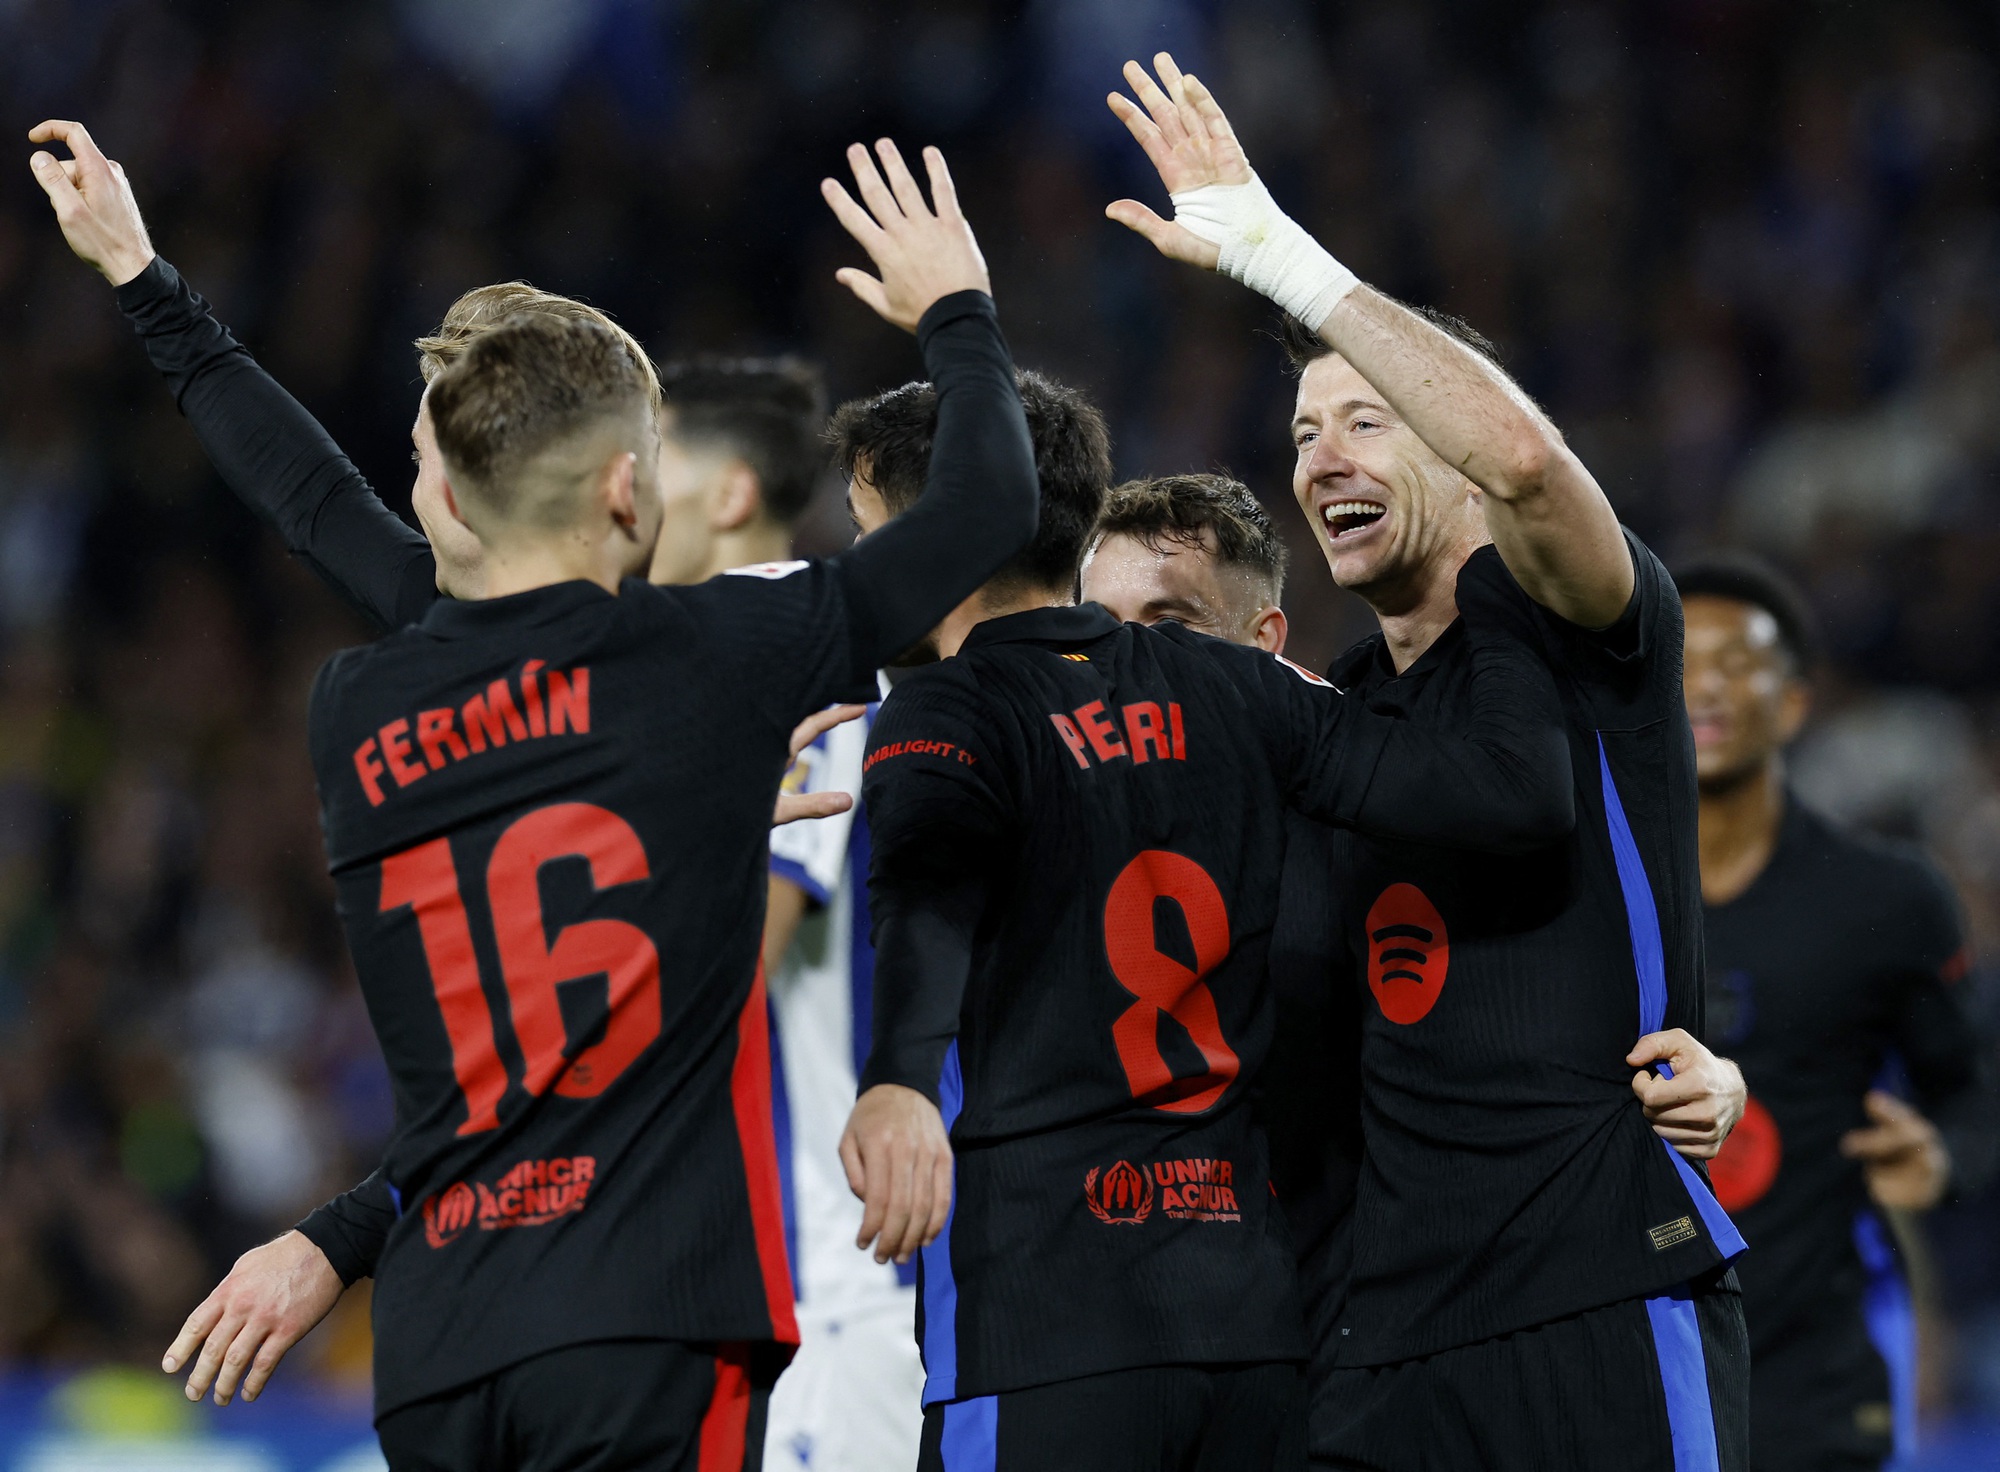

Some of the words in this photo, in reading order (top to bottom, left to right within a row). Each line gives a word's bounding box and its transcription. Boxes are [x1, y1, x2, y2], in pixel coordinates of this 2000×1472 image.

[353, 659, 590, 807] FERMÍN
[380, 802, 662, 1137] 16
[1104, 850, 1241, 1114] 8
[1154, 1158, 1233, 1187] UNHCR
[1162, 1183, 1239, 1212] ACNUR
